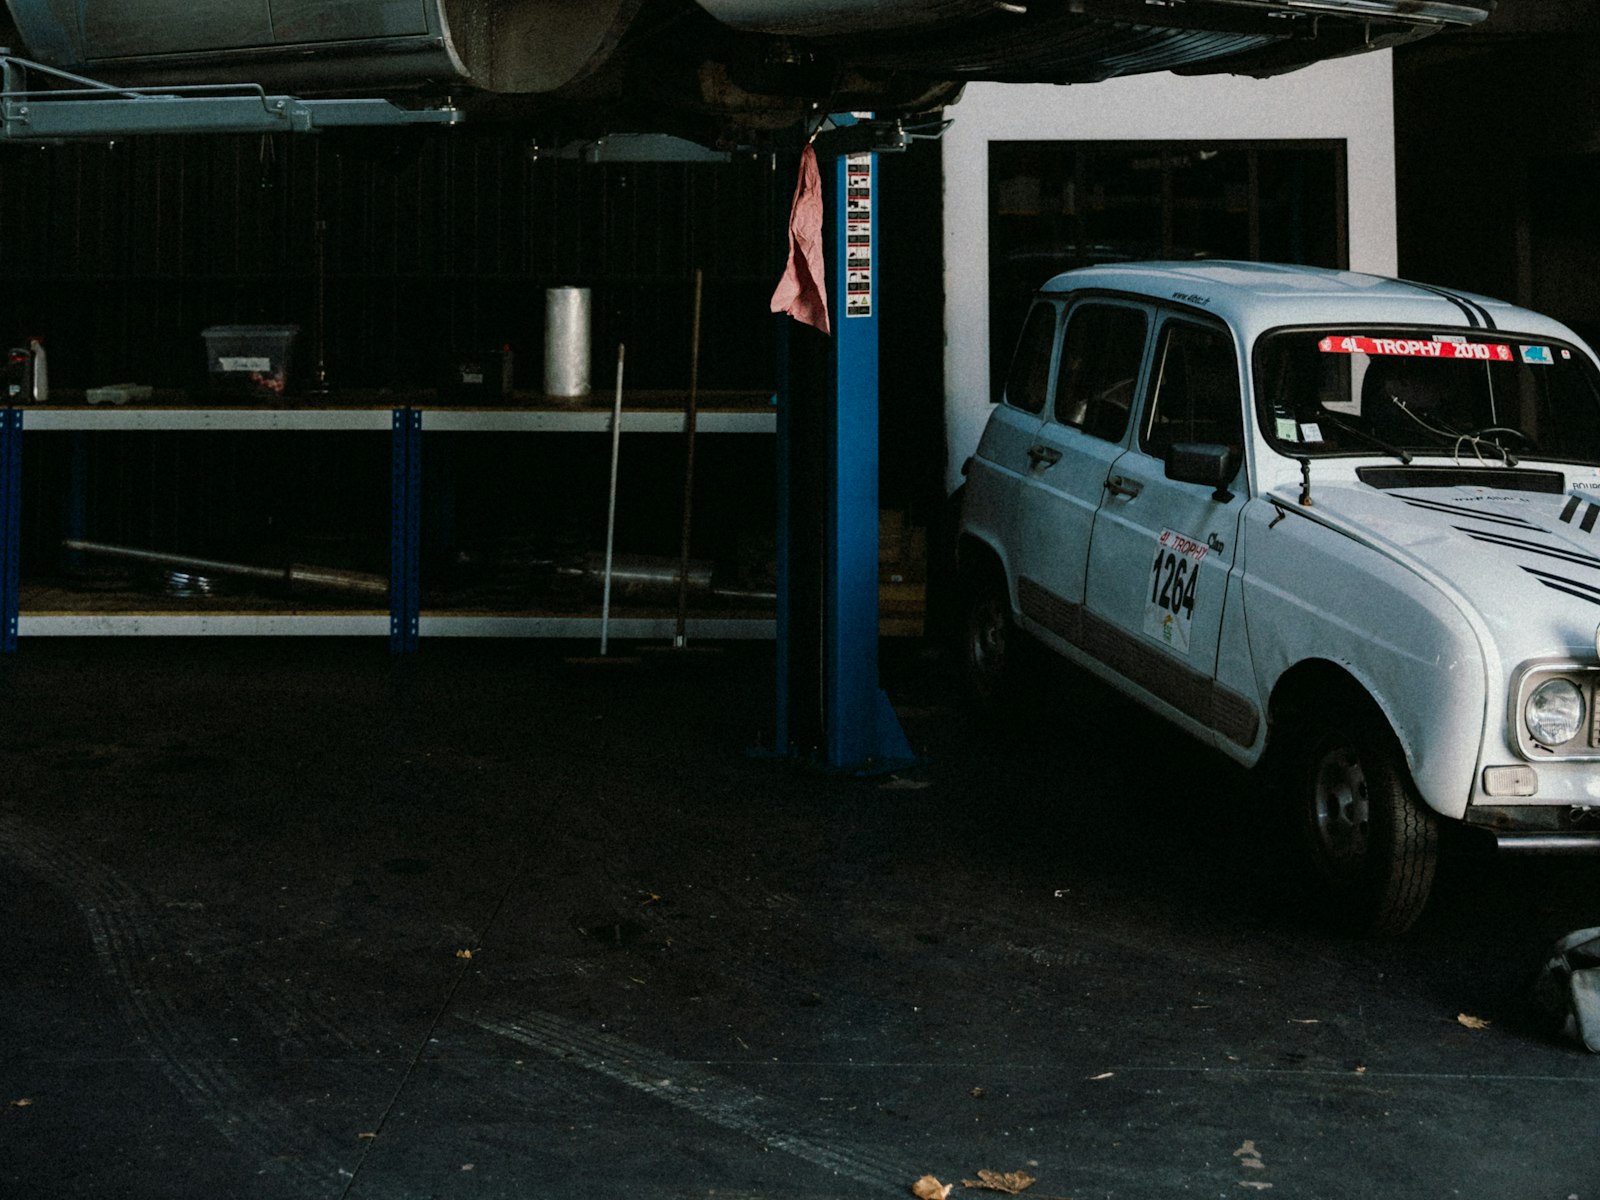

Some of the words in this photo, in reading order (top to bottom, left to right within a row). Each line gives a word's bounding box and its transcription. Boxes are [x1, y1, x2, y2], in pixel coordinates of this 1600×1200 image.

[1341, 338, 1365, 352] 4L
[1372, 339, 1442, 357] TROPHY
[1452, 342, 1490, 359] 2010
[1171, 535, 1208, 560] TROPHY
[1151, 548, 1199, 621] 1264
